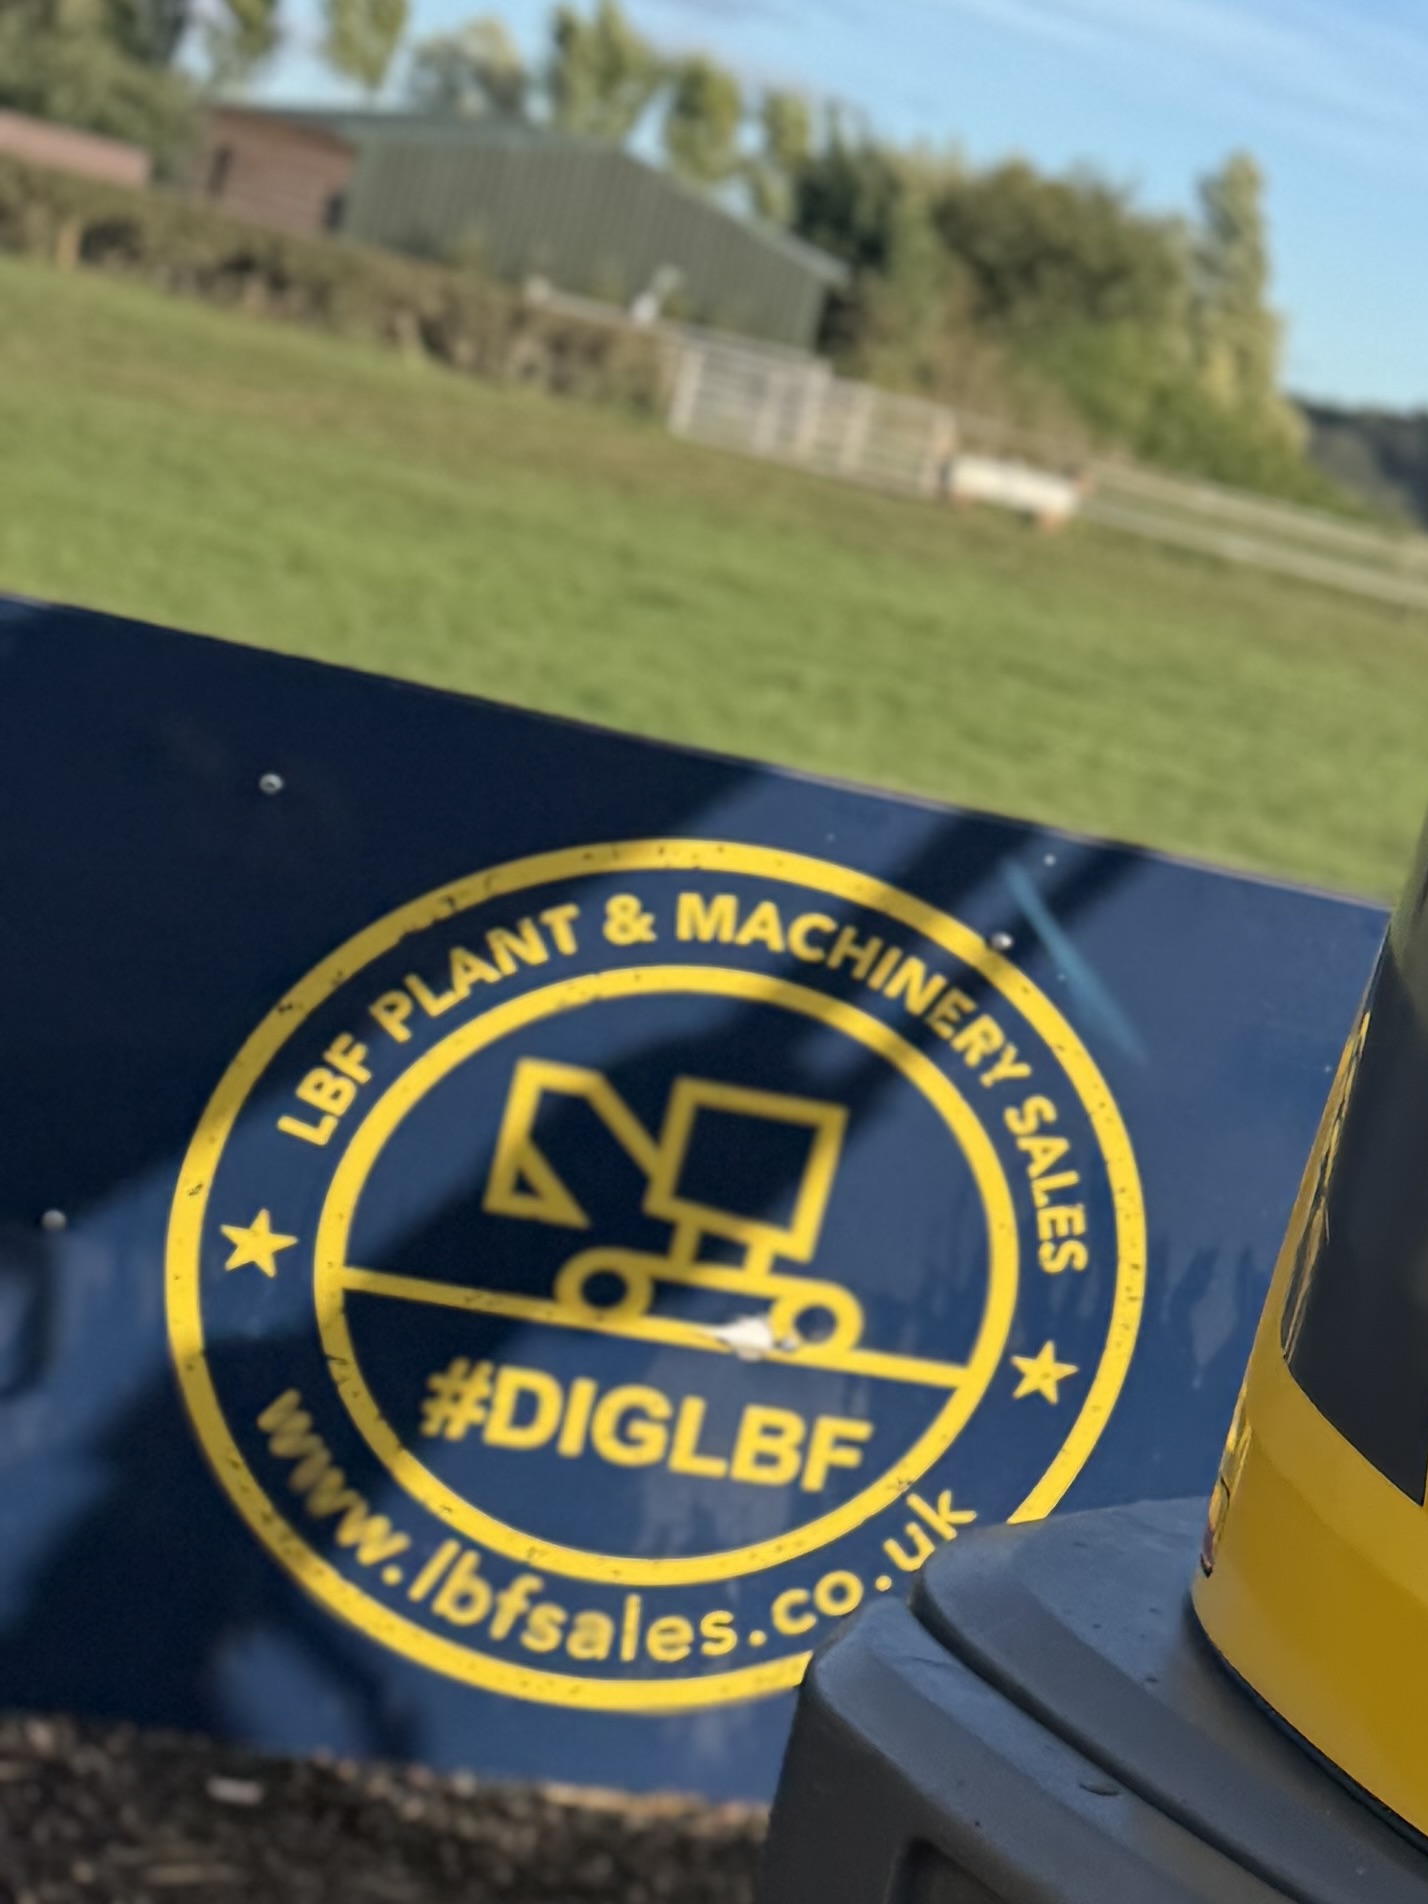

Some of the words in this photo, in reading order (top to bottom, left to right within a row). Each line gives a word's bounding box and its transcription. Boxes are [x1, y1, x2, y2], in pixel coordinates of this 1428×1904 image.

[278, 1031, 373, 1147] LBF
[369, 904, 581, 1043] PLANT
[604, 895, 656, 946] &
[674, 892, 1031, 1091] MACHINERY
[1003, 1094, 1089, 1276] SALES
[257, 1387, 978, 1664] www.lbfsales.co.uk
[420, 1357, 873, 1493] #DIGLBF
